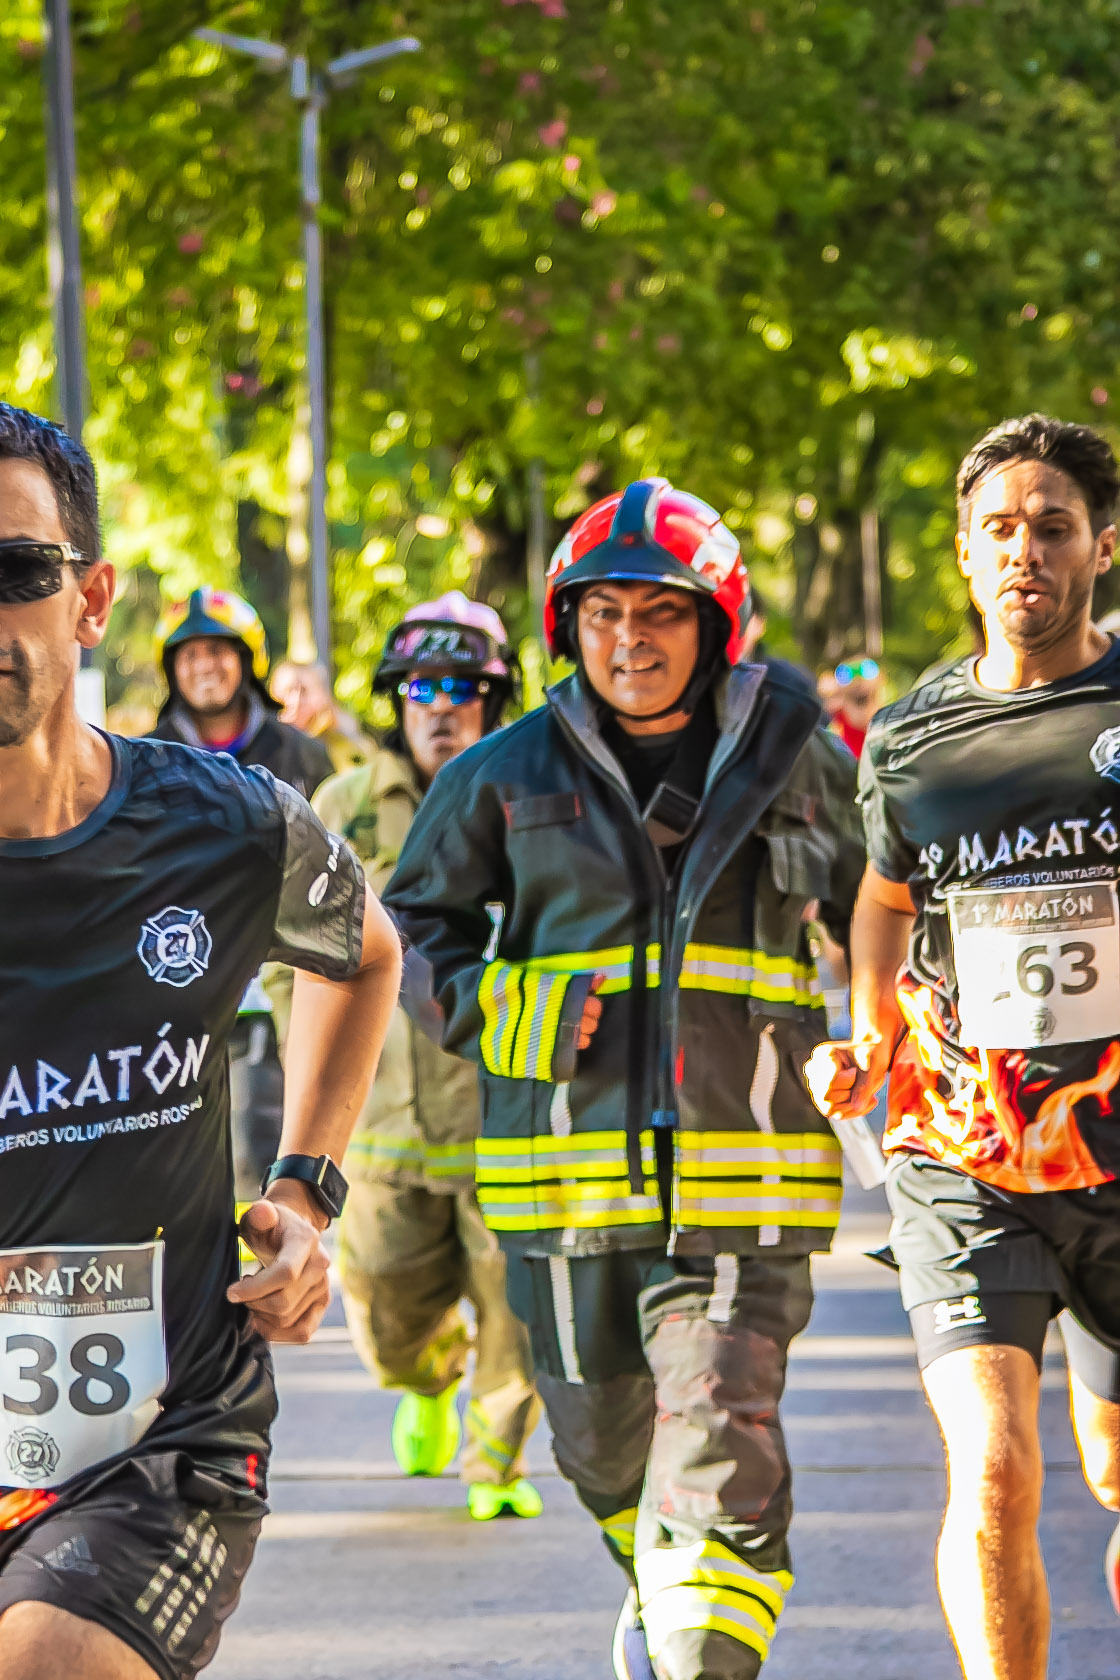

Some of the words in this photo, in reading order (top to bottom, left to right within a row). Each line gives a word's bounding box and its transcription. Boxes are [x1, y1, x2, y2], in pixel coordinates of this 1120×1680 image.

[993, 891, 1094, 922] MARATÓN
[992, 941, 1099, 1003] 63
[52, 1110, 159, 1143] VOLUNTARIOS
[19, 1441, 44, 1464] 27
